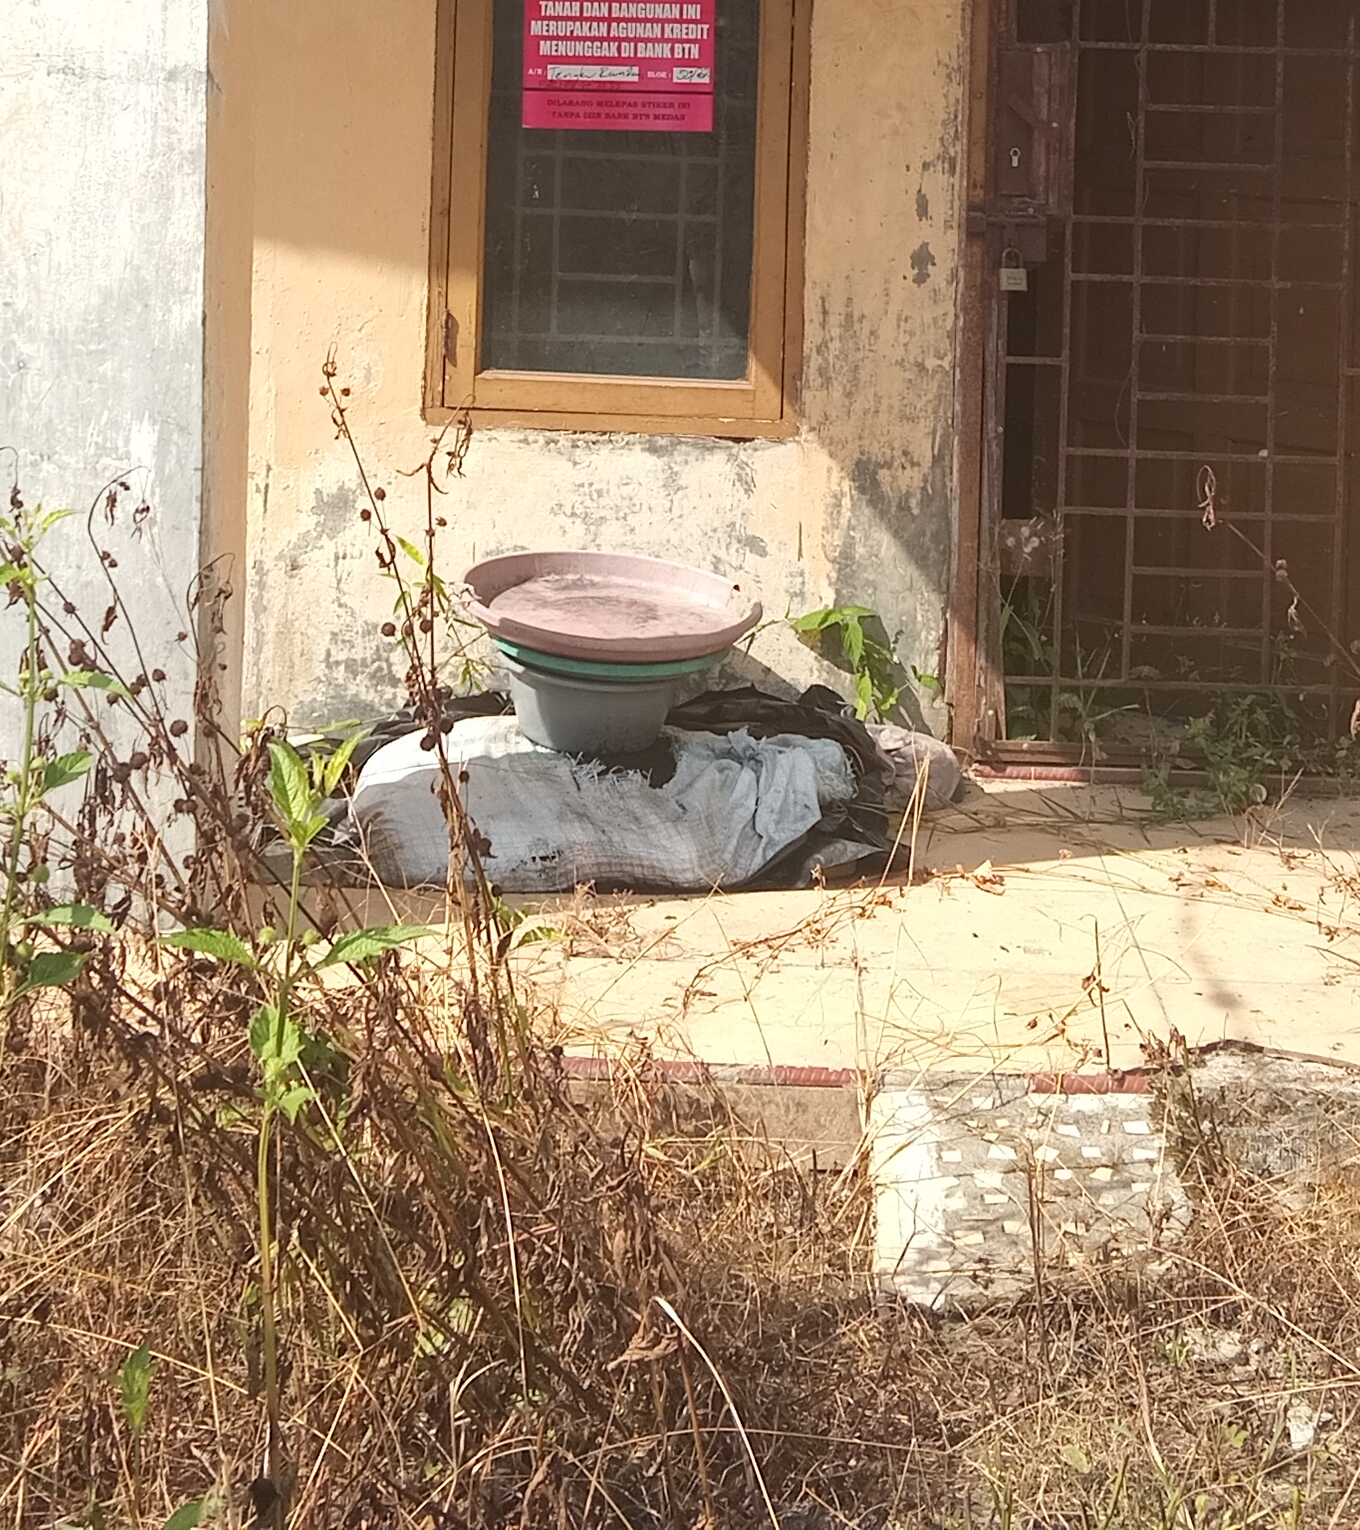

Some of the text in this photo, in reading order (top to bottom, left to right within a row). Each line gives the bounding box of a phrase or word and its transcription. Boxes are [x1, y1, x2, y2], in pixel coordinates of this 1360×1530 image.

[539, 0, 701, 20] TANAH DAN BANGUNAN INI
[530, 20, 710, 40] MERUPAKAN AGUNAN KREDIT
[539, 40, 699, 59] MENUNGGAK DI BANK BTN
[546, 99, 594, 107] DILARANG
[596, 100, 638, 108] MELEPAS
[551, 111, 581, 119] TANPA
[605, 112, 630, 120] BANK
